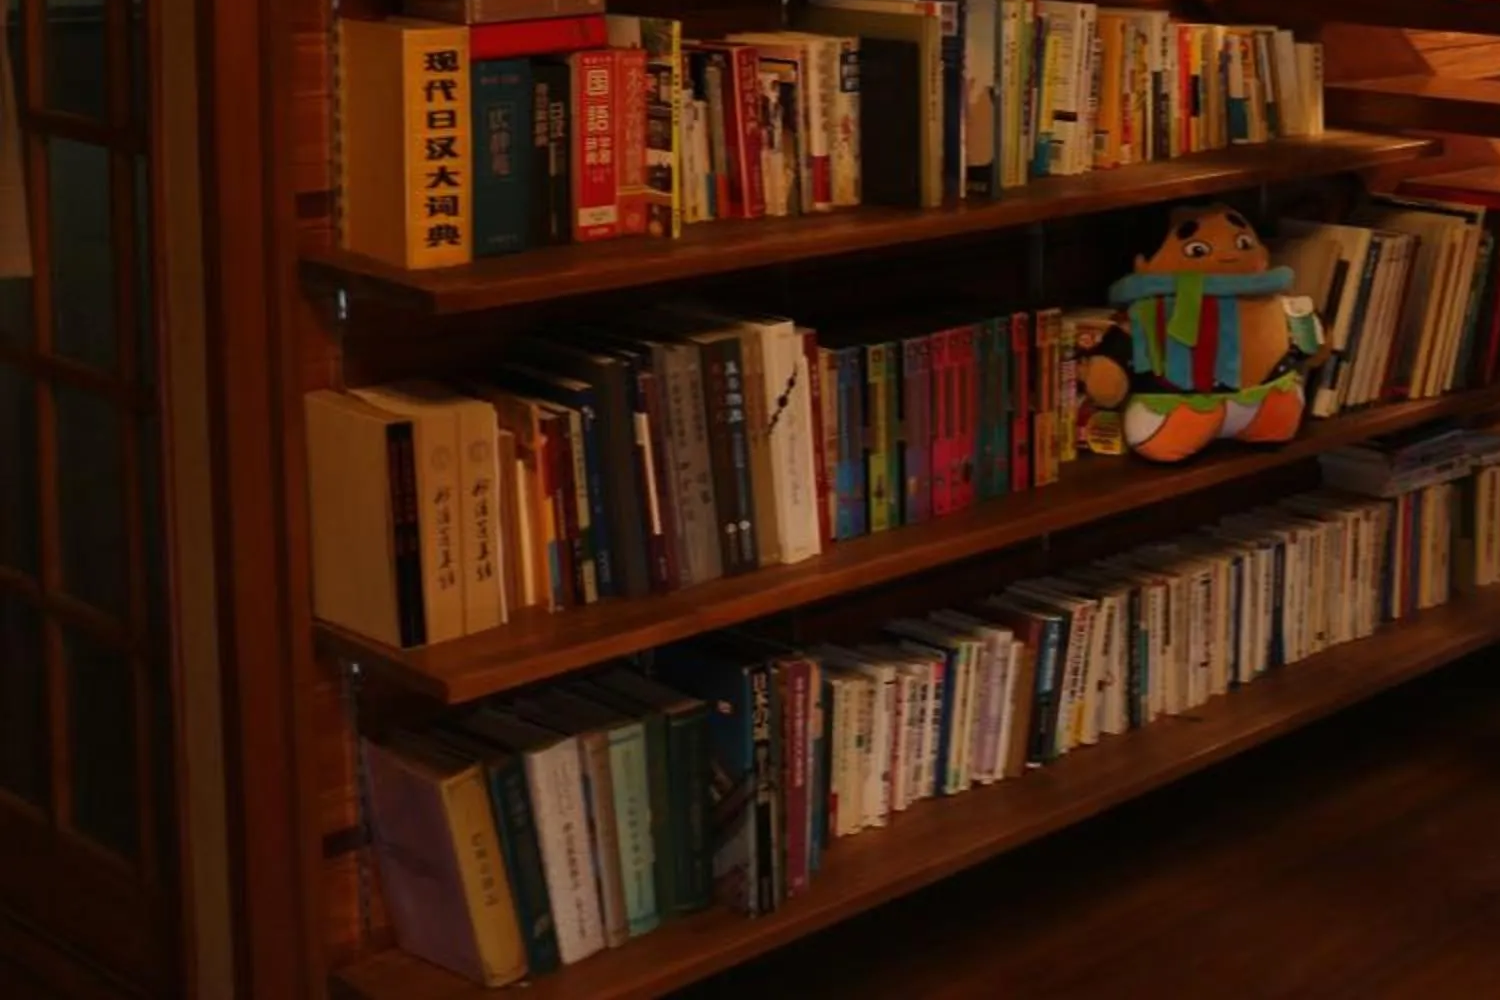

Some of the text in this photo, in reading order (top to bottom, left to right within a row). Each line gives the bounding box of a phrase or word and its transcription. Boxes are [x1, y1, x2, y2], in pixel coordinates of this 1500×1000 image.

[423, 49, 462, 248] 现代日汉大词典
